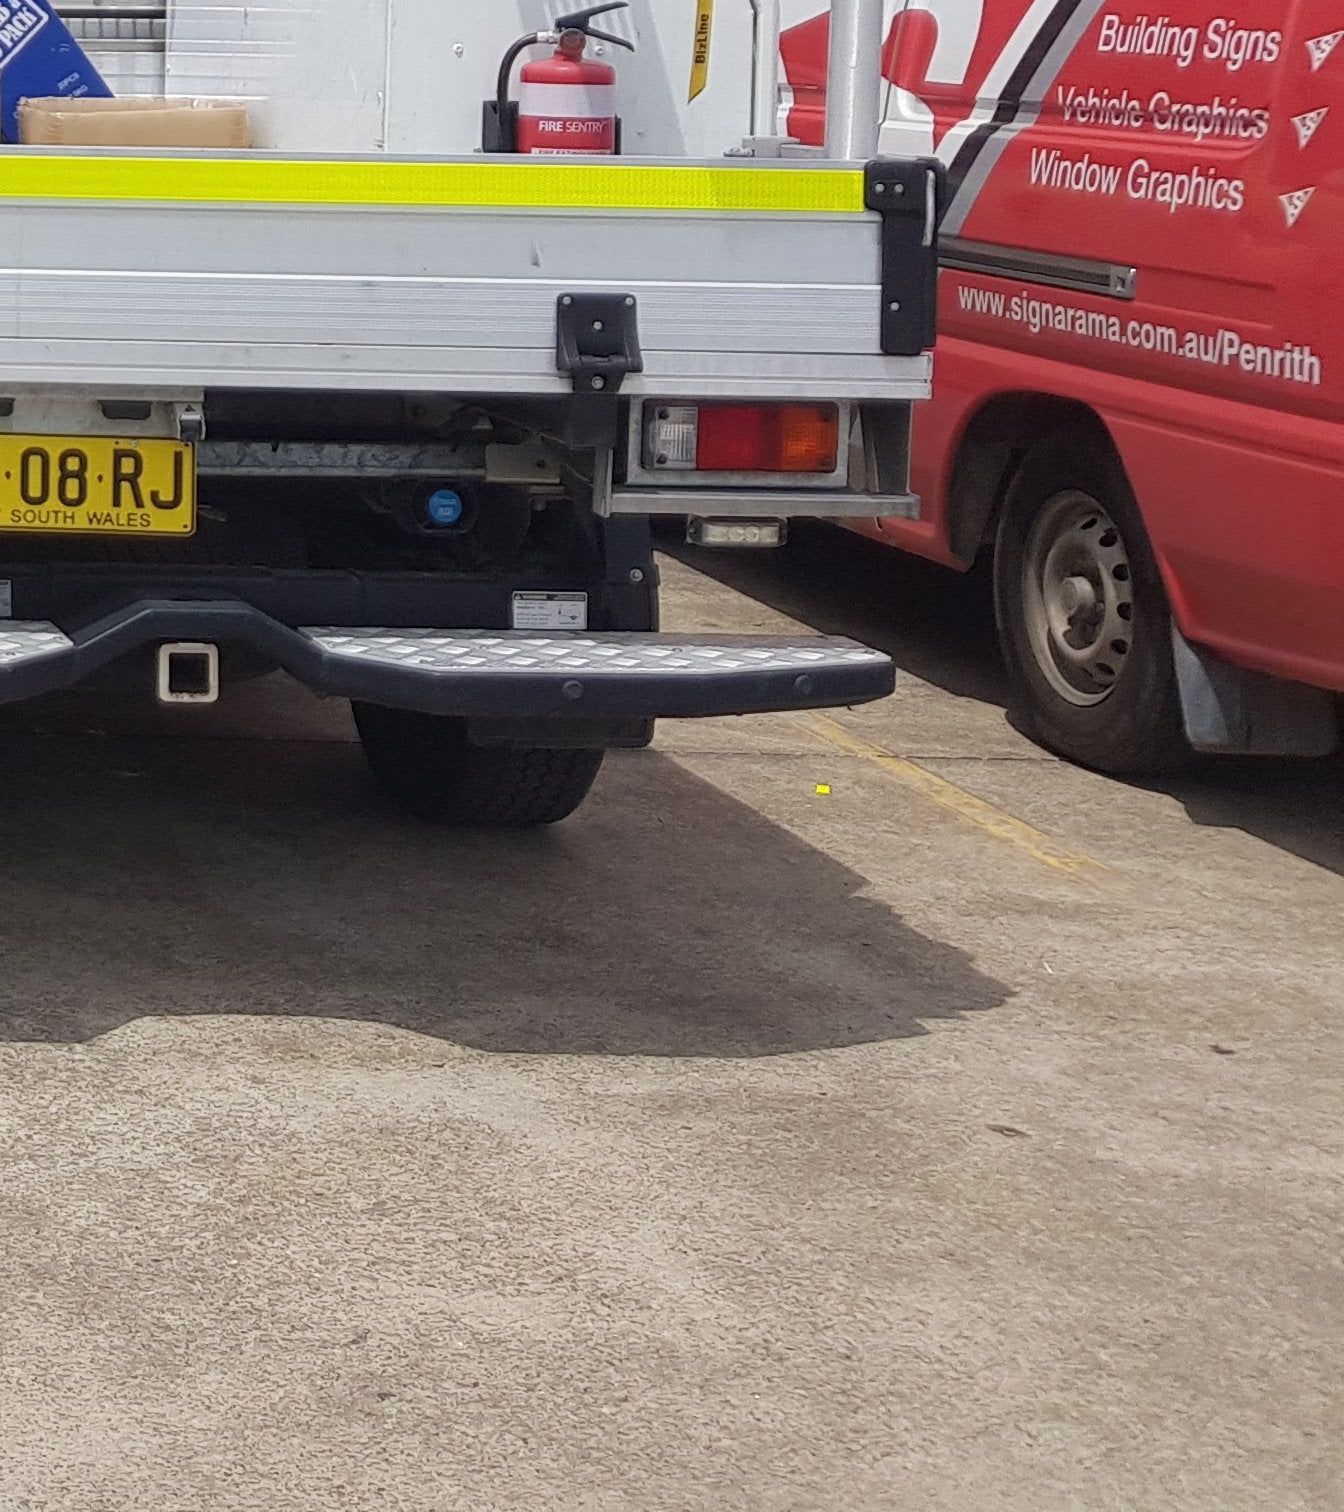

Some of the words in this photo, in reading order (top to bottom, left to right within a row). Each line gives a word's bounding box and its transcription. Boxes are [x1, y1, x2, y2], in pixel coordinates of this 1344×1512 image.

[1097, 14, 1199, 68] Building
[1203, 18, 1282, 72] Signs
[538, 120, 564, 132] FIRE
[565, 121, 605, 133] SENTRY
[1056, 84, 1145, 127] Vehicle
[1148, 91, 1270, 143] Graphics
[1029, 147, 1122, 195] Window
[1127, 158, 1245, 214] Graphics
[957, 285, 1322, 385] www.signarama.com.au/Penrith
[10, 508, 75, 525] SOUTH
[86, 511, 151, 527] WALES
